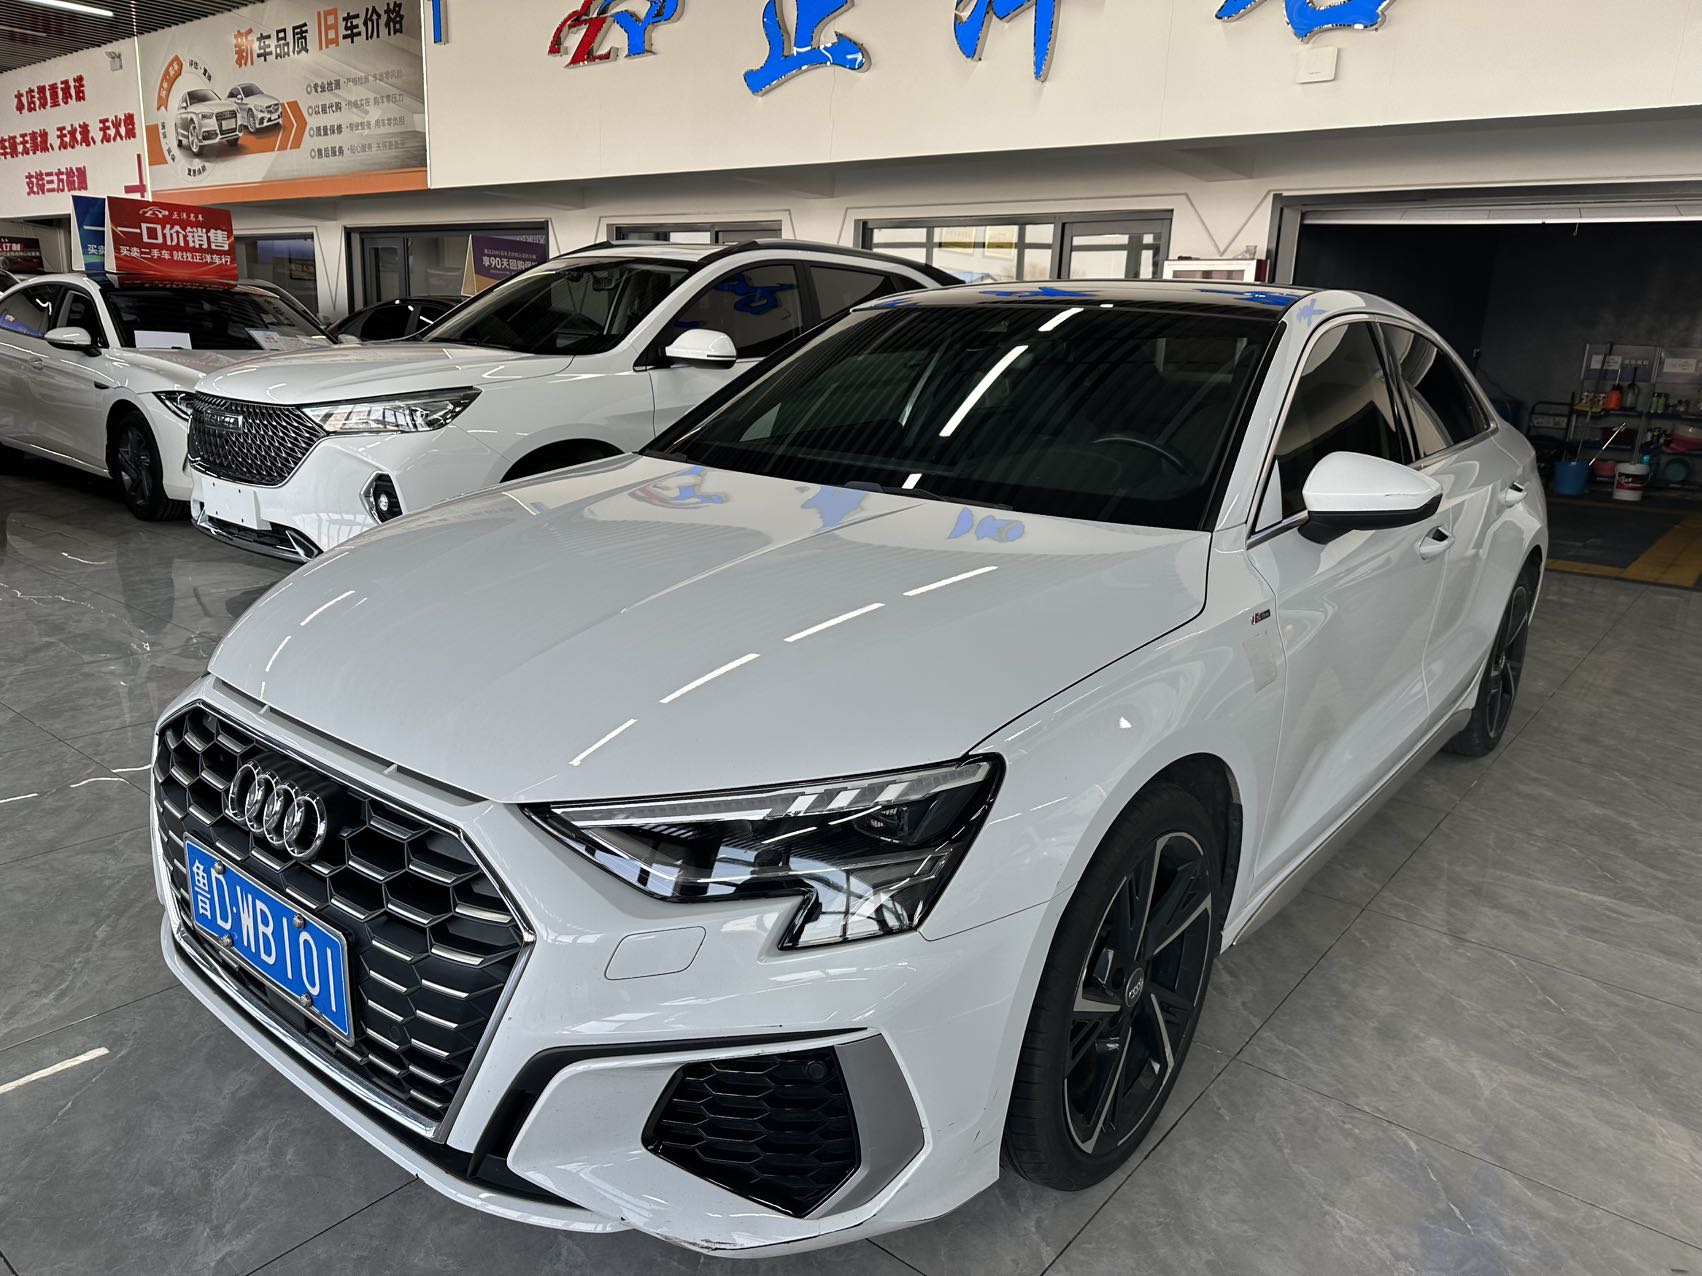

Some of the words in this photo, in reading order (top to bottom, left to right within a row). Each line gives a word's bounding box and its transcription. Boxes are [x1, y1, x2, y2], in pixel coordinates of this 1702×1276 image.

[233, 22, 309, 68] 新车品质
[316, 1, 405, 51] 旧车价格
[14, 74, 86, 114] 本店郑重承诺
[312, 79, 341, 94] 专业检测
[314, 101, 342, 116] 以租代购
[315, 123, 343, 137] 质量保修
[316, 145, 345, 159] 售后服务
[25, 165, 88, 196] 支持三方检测
[116, 222, 230, 251] 一口价销售
[119, 245, 171, 260] 买卖二手车
[172, 251, 232, 265] 就找正洋车行
[482, 256, 538, 271] 享90天回购保
